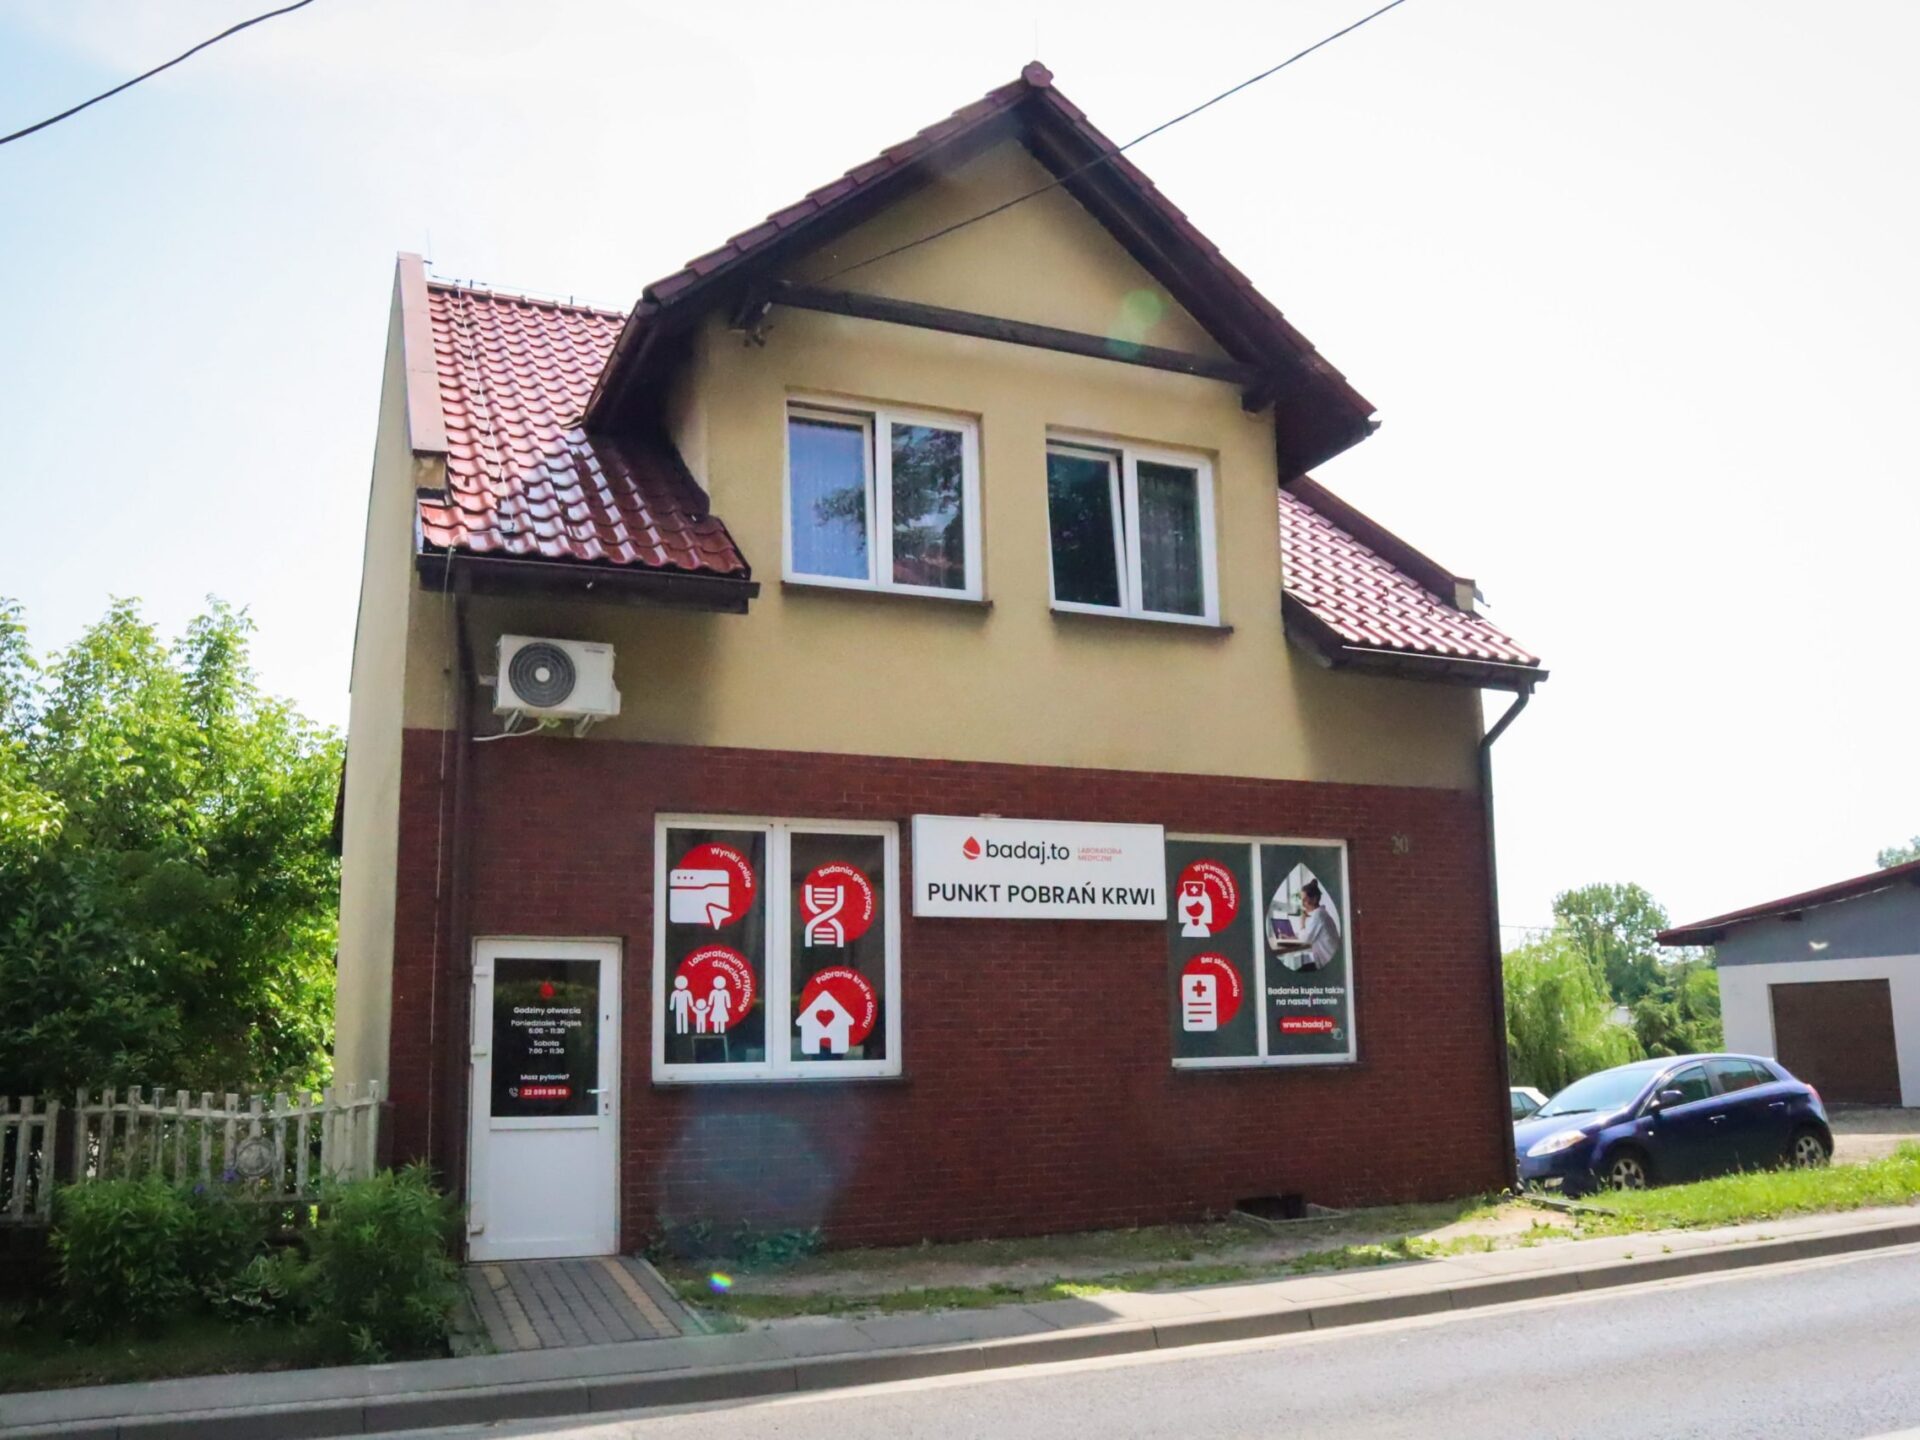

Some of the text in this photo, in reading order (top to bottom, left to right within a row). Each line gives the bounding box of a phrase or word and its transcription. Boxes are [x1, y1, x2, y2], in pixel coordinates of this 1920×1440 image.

[986, 840, 1069, 864] badaj.to
[710, 846, 752, 889] Wyniki online
[818, 864, 875, 922] Badania genetyczne
[928, 881, 1156, 906] PUNKT POBRAŃ KRWI
[688, 949, 755, 1013] Laboratorium przyjazne
[712, 959, 741, 990] dzieciom
[815, 970, 874, 1029] Pobranie krwi w domu
[1267, 985, 1299, 995] Badania
[1300, 985, 1324, 996] kupisz
[1275, 996, 1338, 1008] na naszej stronie
[513, 1006, 582, 1016] Godziny otwarcia
[1281, 1019, 1333, 1030] www.badaj.to
[533, 1039, 560, 1047] Sobota
[539, 1073, 570, 1082] pytania?
